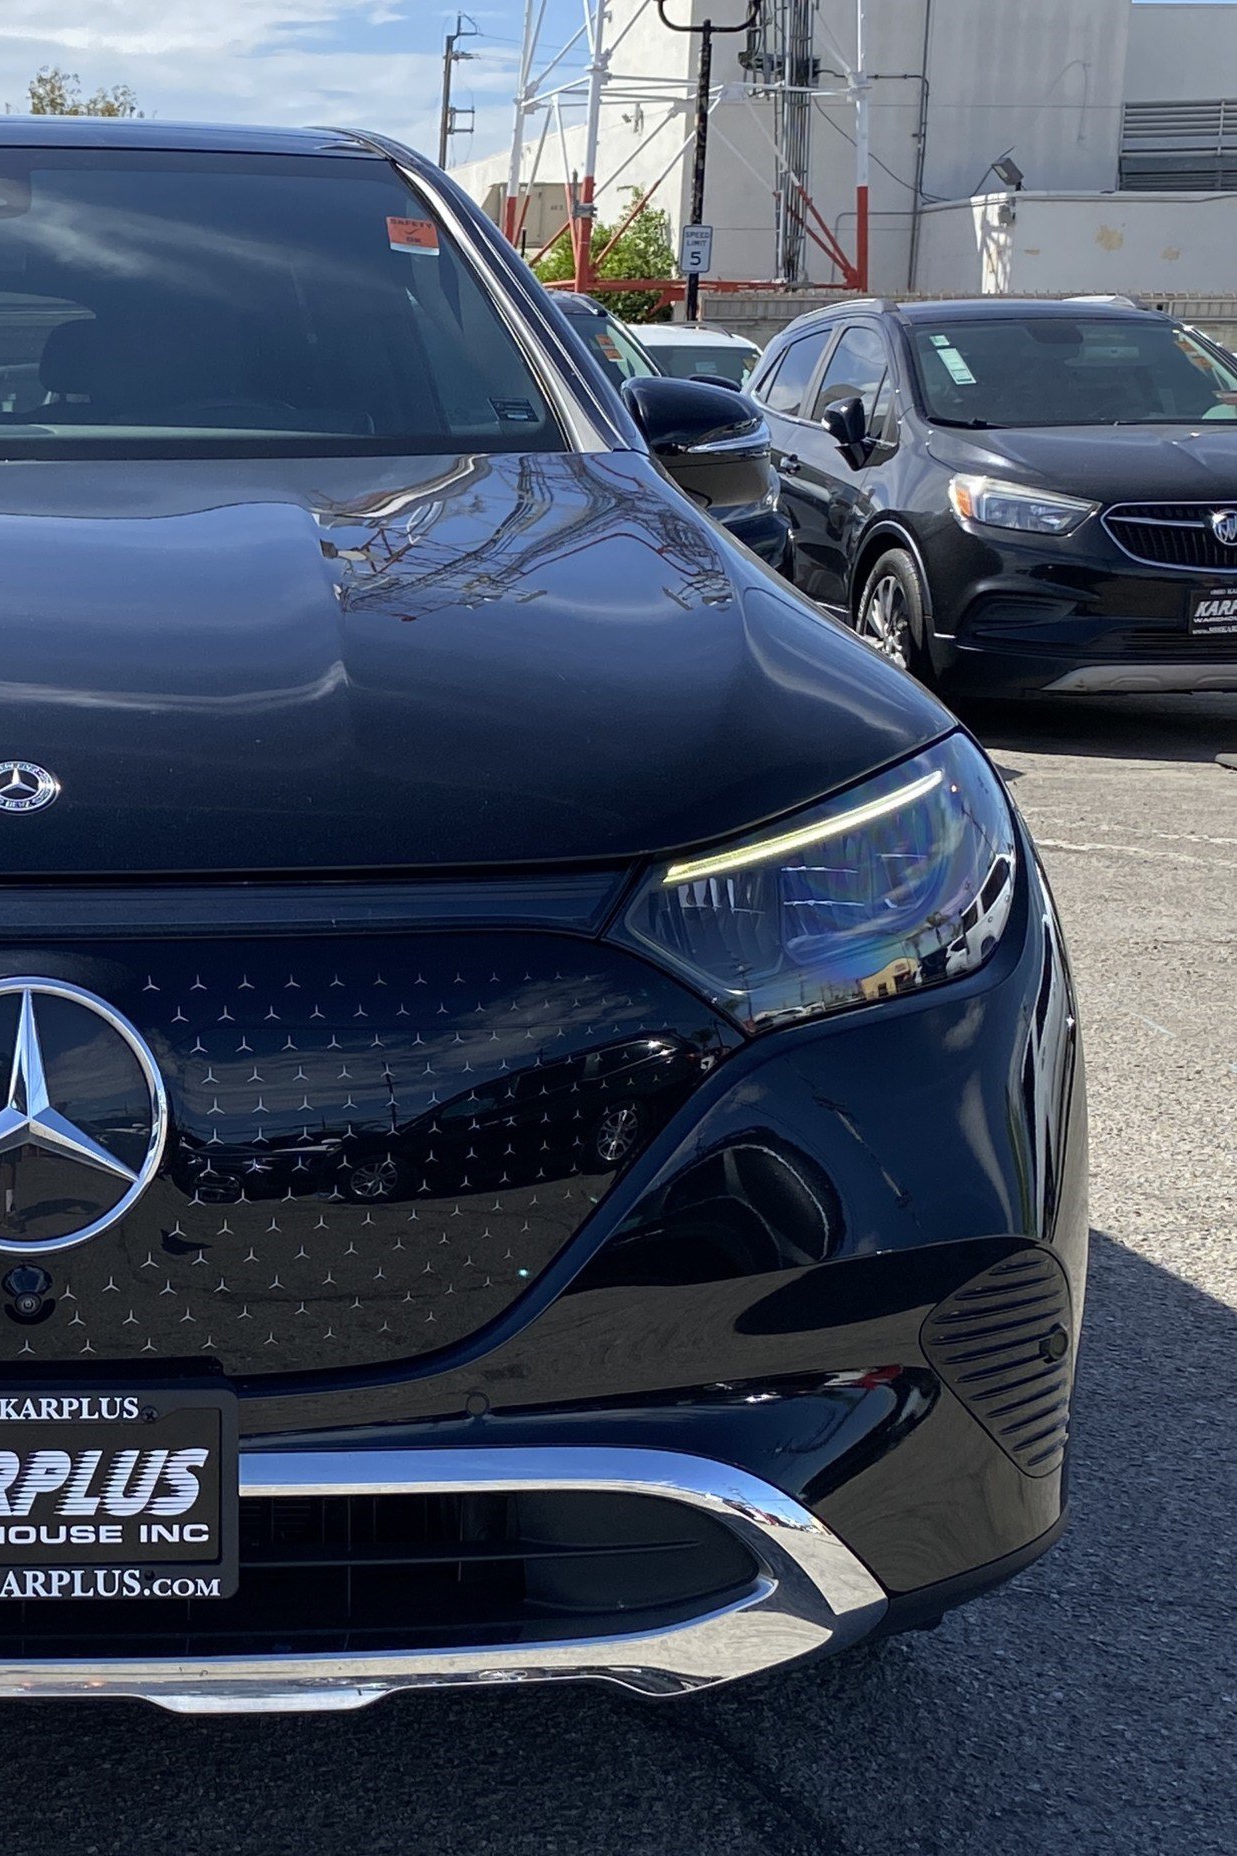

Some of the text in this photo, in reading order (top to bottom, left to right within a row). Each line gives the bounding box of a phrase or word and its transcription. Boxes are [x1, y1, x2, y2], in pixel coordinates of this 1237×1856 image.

[389, 218, 433, 229] SAFETY
[685, 231, 710, 239] SPEED
[689, 250, 702, 266] 5
[139, 1523, 210, 1543] INC
